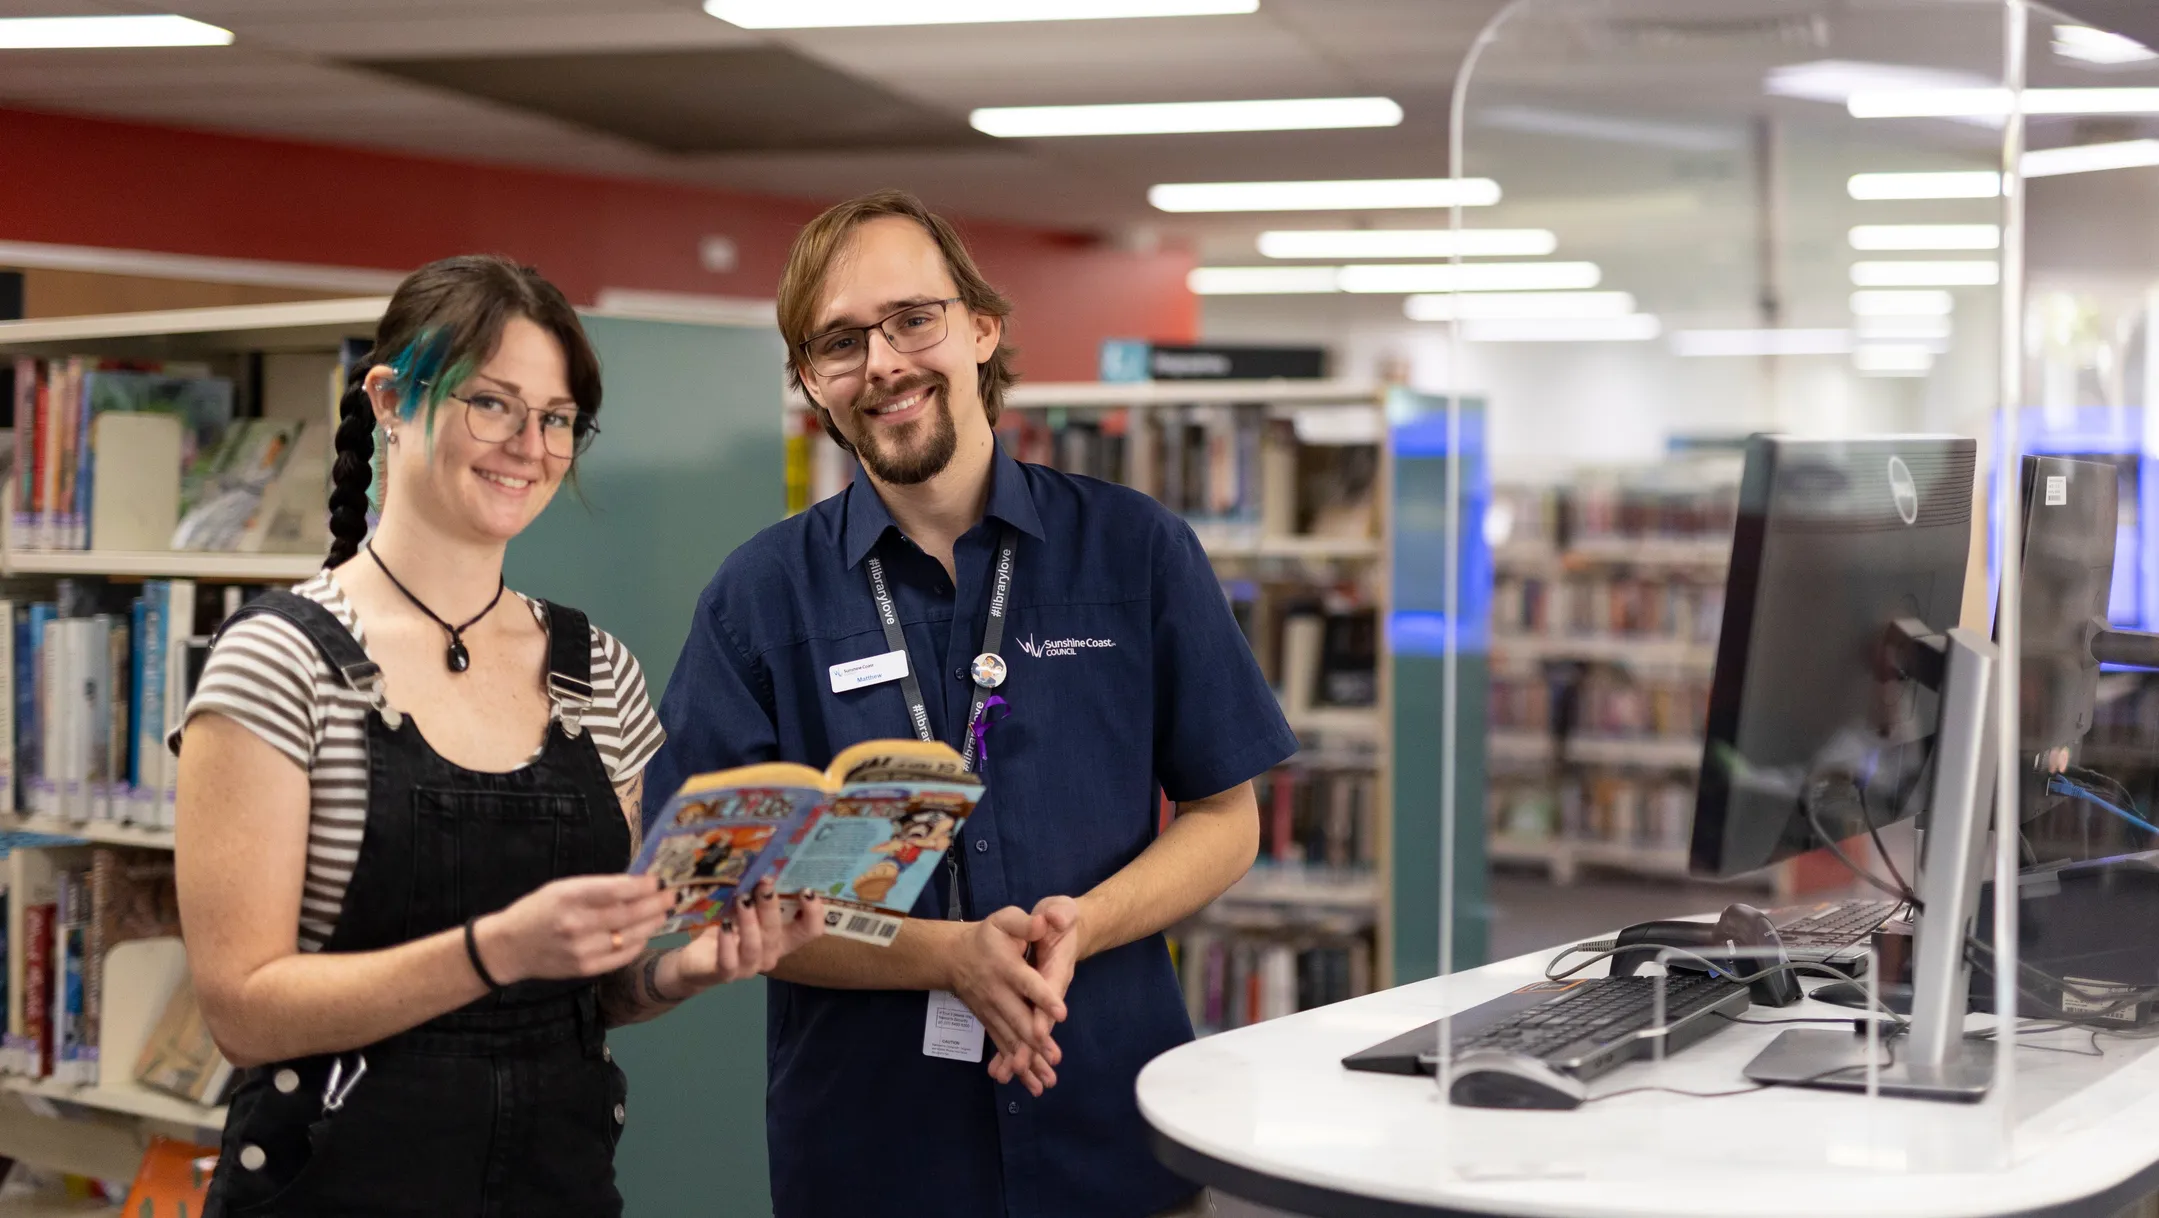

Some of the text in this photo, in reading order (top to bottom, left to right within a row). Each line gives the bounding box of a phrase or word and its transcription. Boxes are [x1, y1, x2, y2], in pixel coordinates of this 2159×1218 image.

[868, 557, 895, 625] #librarylove
[991, 548, 1011, 618] #librarylove
[1044, 638, 1085, 649] Sunshine
[1086, 638, 1112, 648] Coast
[1046, 648, 1077, 656] COUNCIL
[857, 673, 882, 683] Matthew
[912, 703, 931, 744] #librar
